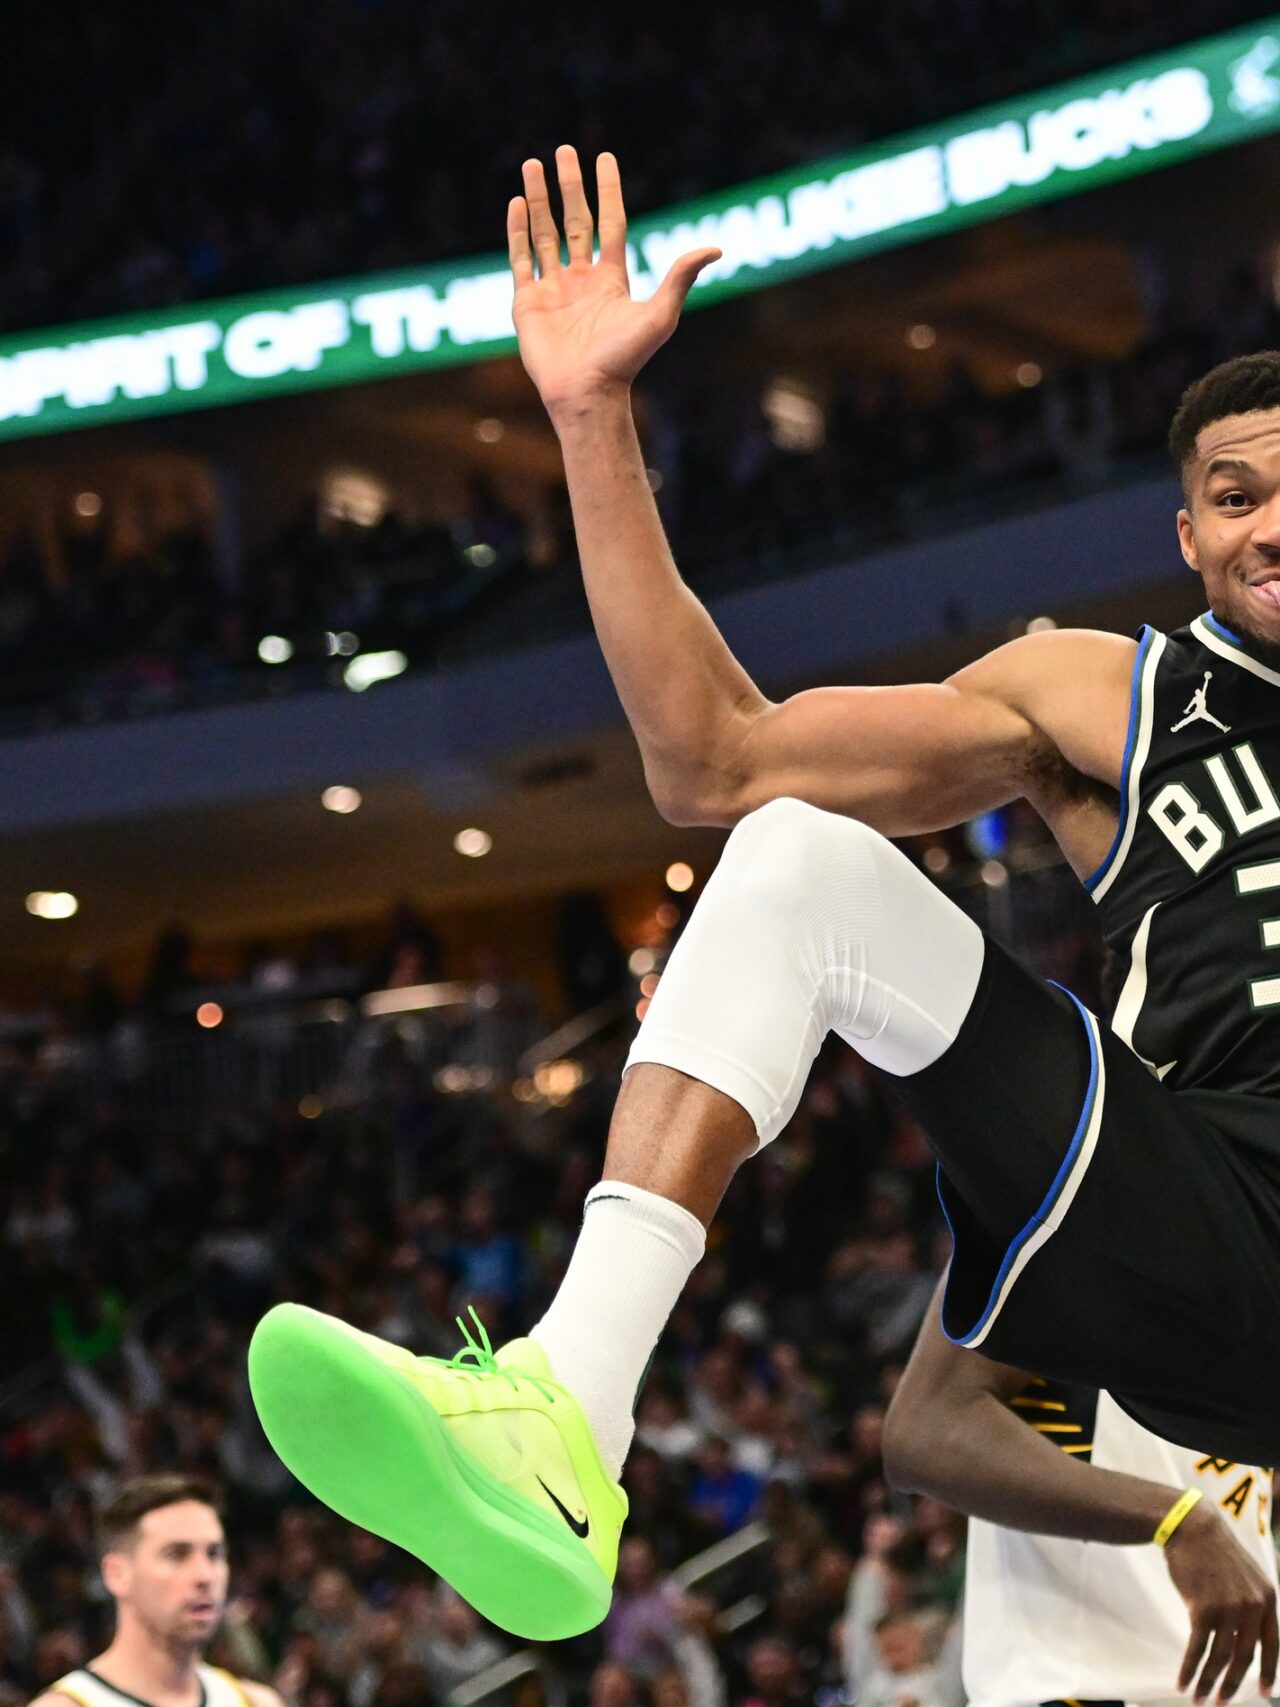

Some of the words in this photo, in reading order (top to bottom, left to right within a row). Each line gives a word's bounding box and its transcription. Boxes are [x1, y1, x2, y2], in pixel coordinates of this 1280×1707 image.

[0, 319, 222, 421] PIRIT
[223, 301, 350, 379] OF
[352, 268, 518, 358] THE
[946, 67, 1213, 206] BUCKS
